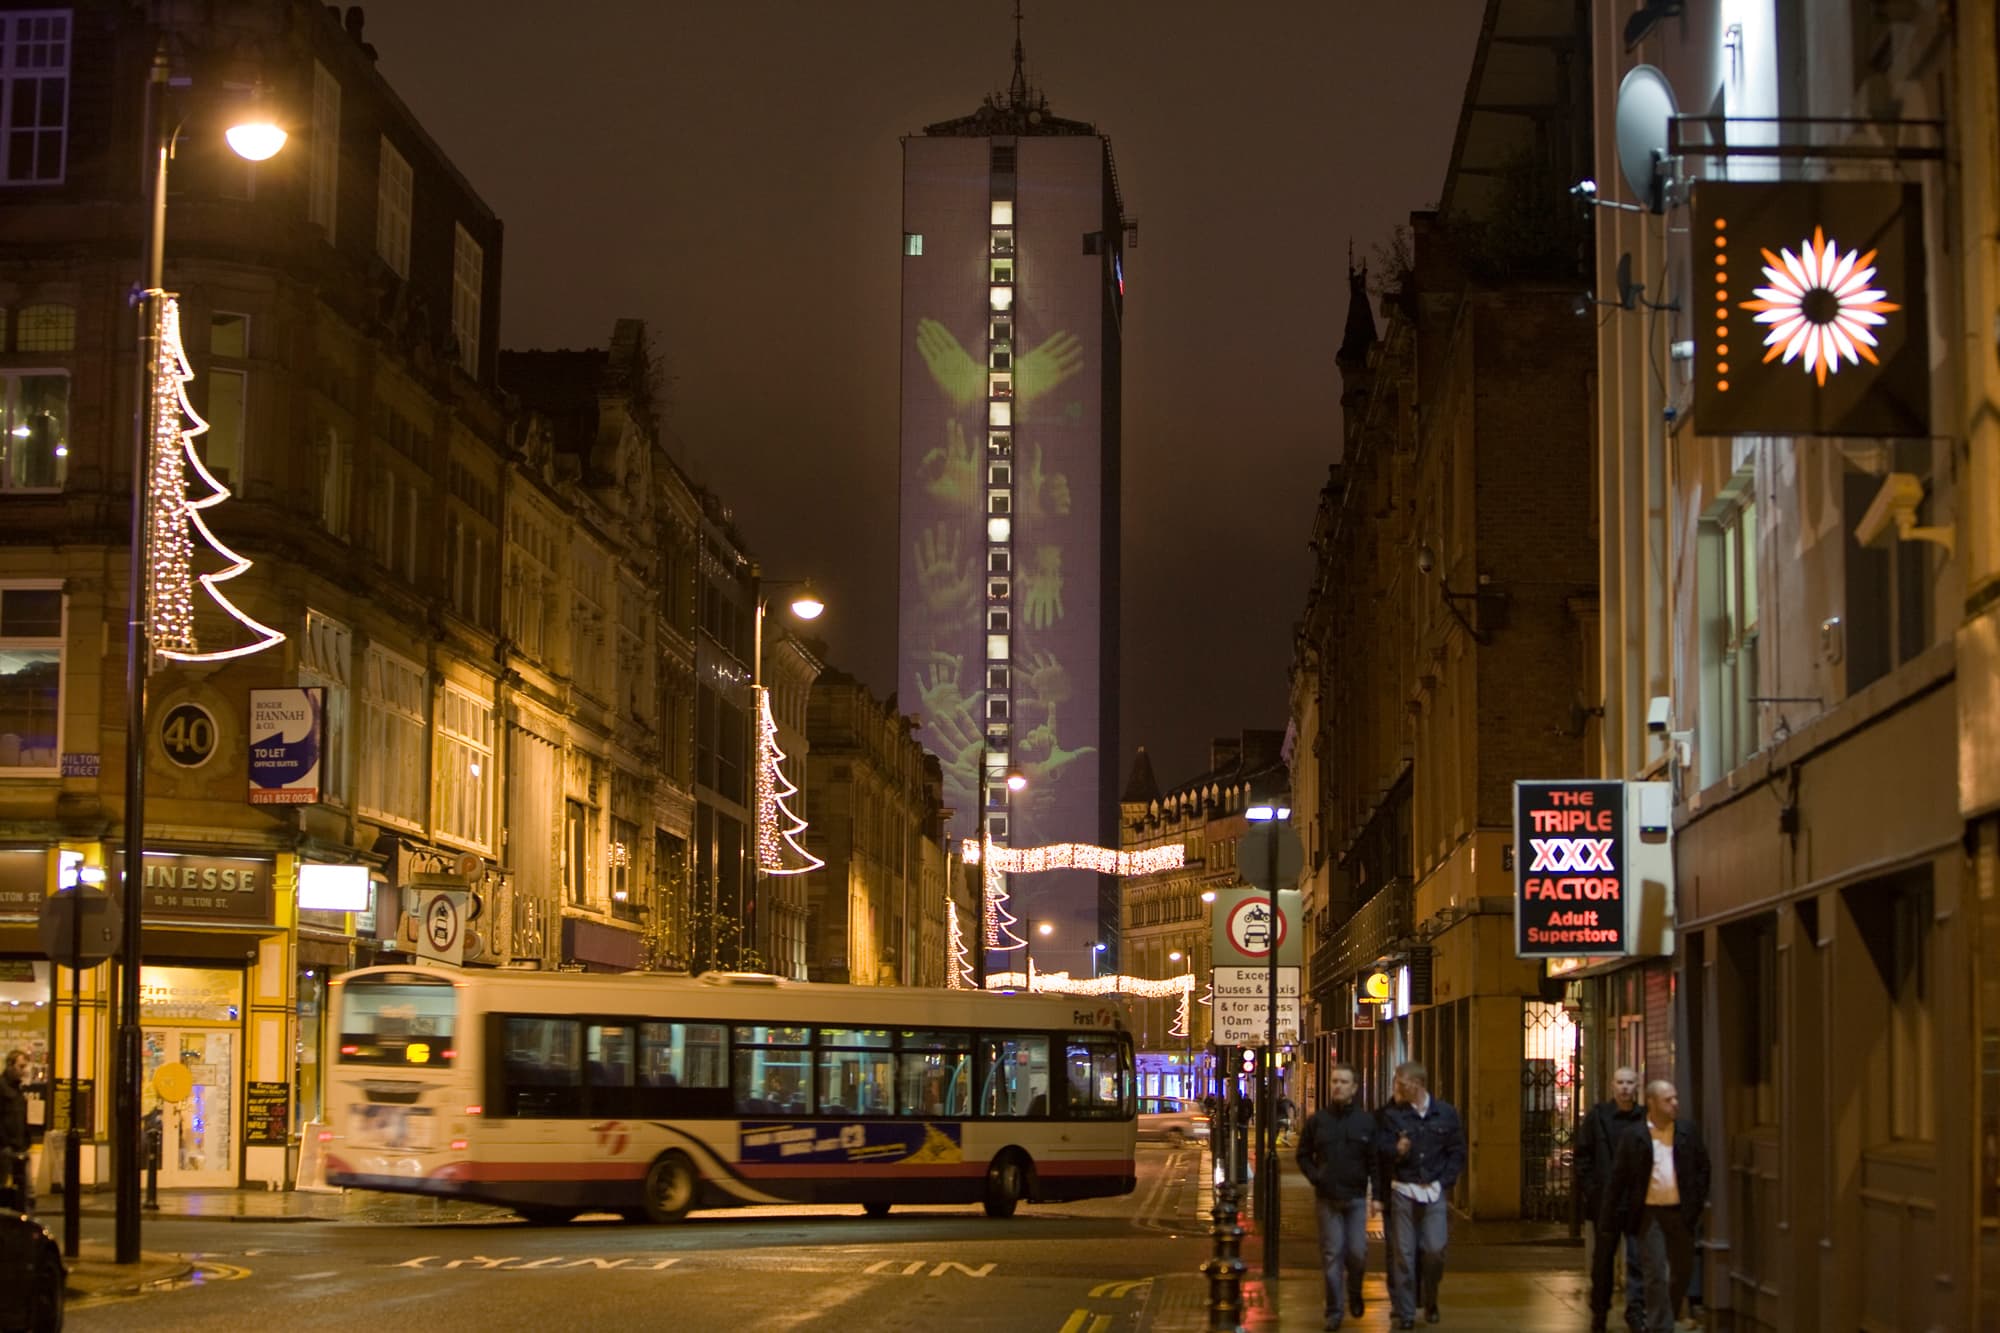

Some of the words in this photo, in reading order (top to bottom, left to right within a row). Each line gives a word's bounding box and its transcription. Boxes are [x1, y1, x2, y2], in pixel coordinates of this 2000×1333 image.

[256, 711, 304, 721] HANNAH
[164, 716, 213, 754] 40
[254, 748, 268, 758] TO
[269, 748, 286, 758] LET
[62, 755, 101, 765] HILTON
[62, 766, 101, 776] STREET
[1548, 791, 1594, 806] THE
[1529, 809, 1613, 833] TRIPLE
[1528, 838, 1615, 872] XXX
[145, 865, 255, 892] INESSE
[1524, 878, 1620, 901] FACTOR
[182, 896, 212, 907] HILTON
[215, 898, 229, 908] ST.
[1547, 910, 1599, 927] Adult
[1527, 927, 1619, 944] Superstore
[1237, 970, 1271, 981] Excep
[1218, 985, 1251, 994] buses
[1255, 985, 1263, 994] &
[1272, 985, 1295, 994] xis
[1220, 1002, 1228, 1011] &
[1233, 1002, 1248, 1011] for
[1253, 1003, 1293, 1011] acss
[1073, 1010, 1094, 1024] First
[1222, 1016, 1253, 1025] 10am
[1225, 1030, 1250, 1041] 6pm
[1264, 1030, 1288, 1040] 8m
